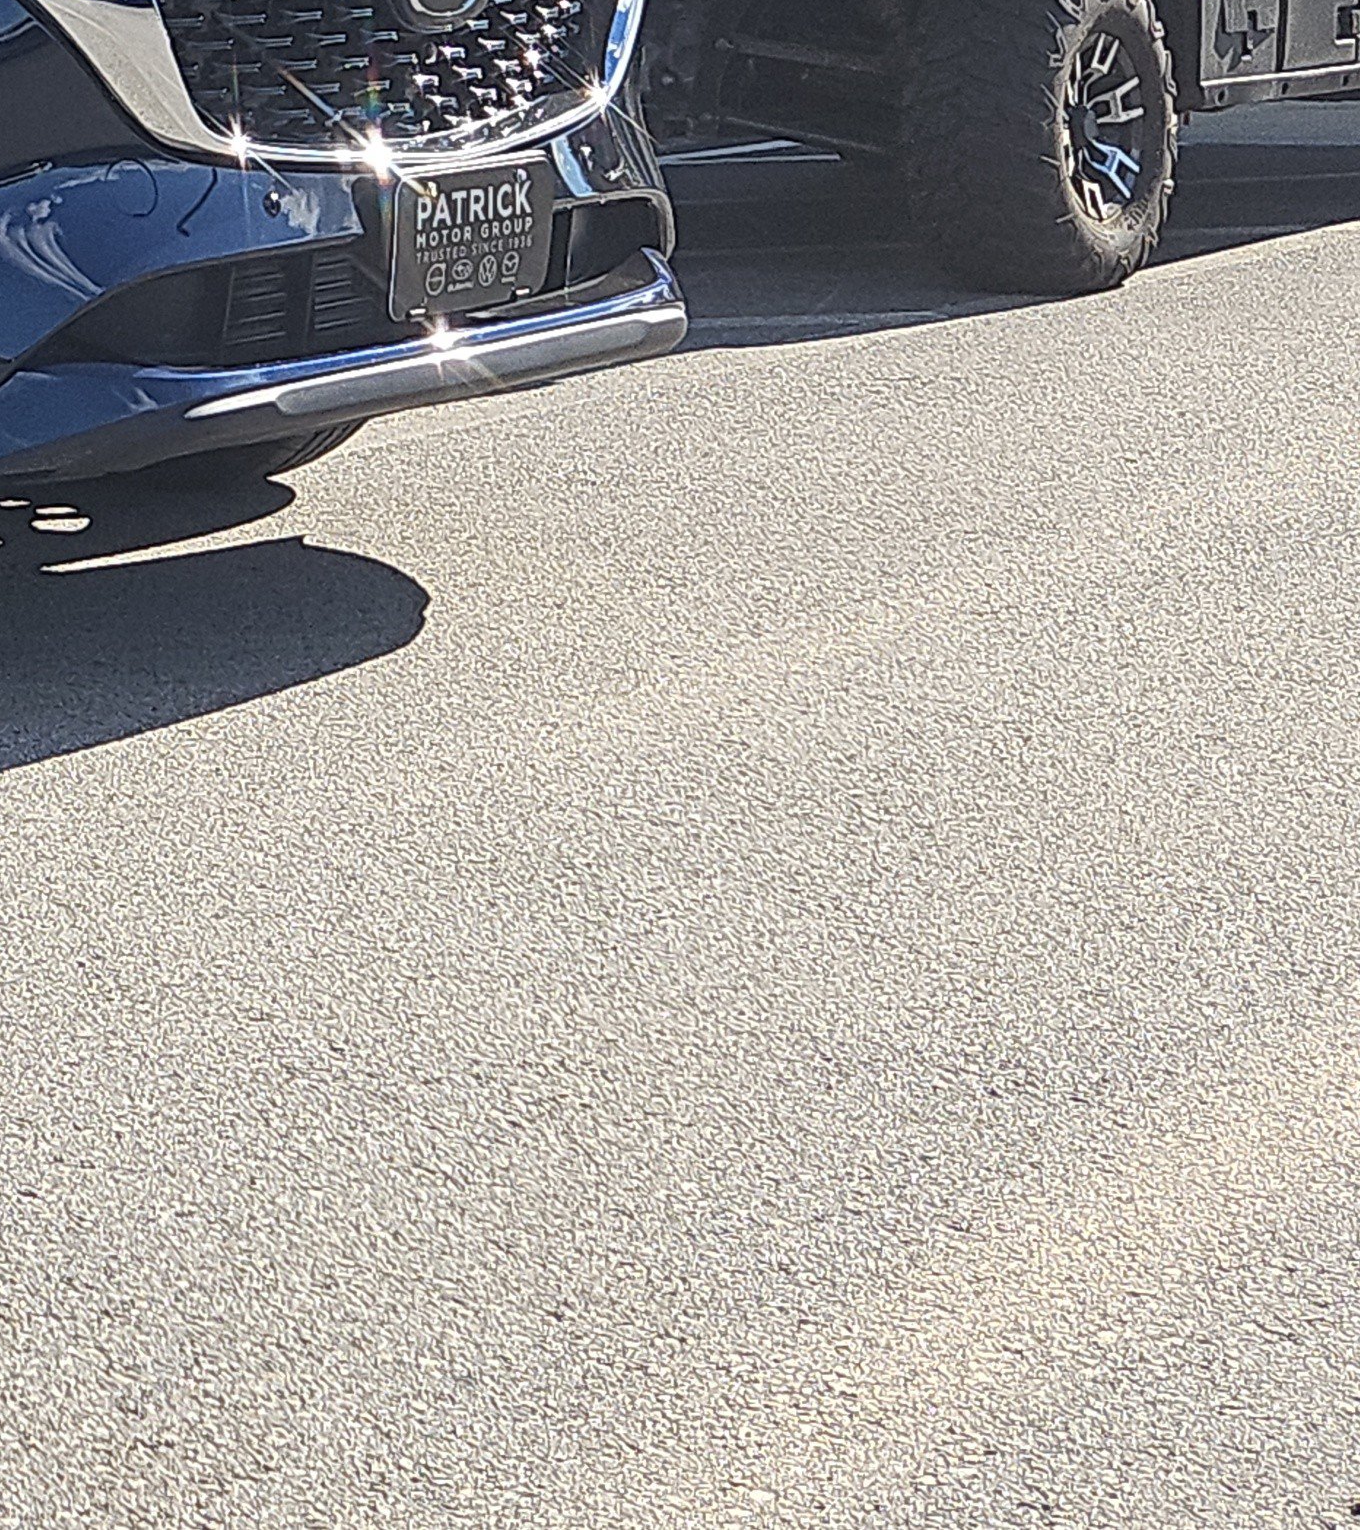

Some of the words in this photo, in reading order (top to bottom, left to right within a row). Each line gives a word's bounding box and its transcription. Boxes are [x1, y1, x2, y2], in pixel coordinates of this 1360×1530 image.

[416, 180, 533, 231] PATRICK
[416, 226, 472, 249] MOTOR
[480, 217, 533, 238] GROUP
[416, 245, 467, 264] TRUSTED
[471, 239, 504, 256] SINCE
